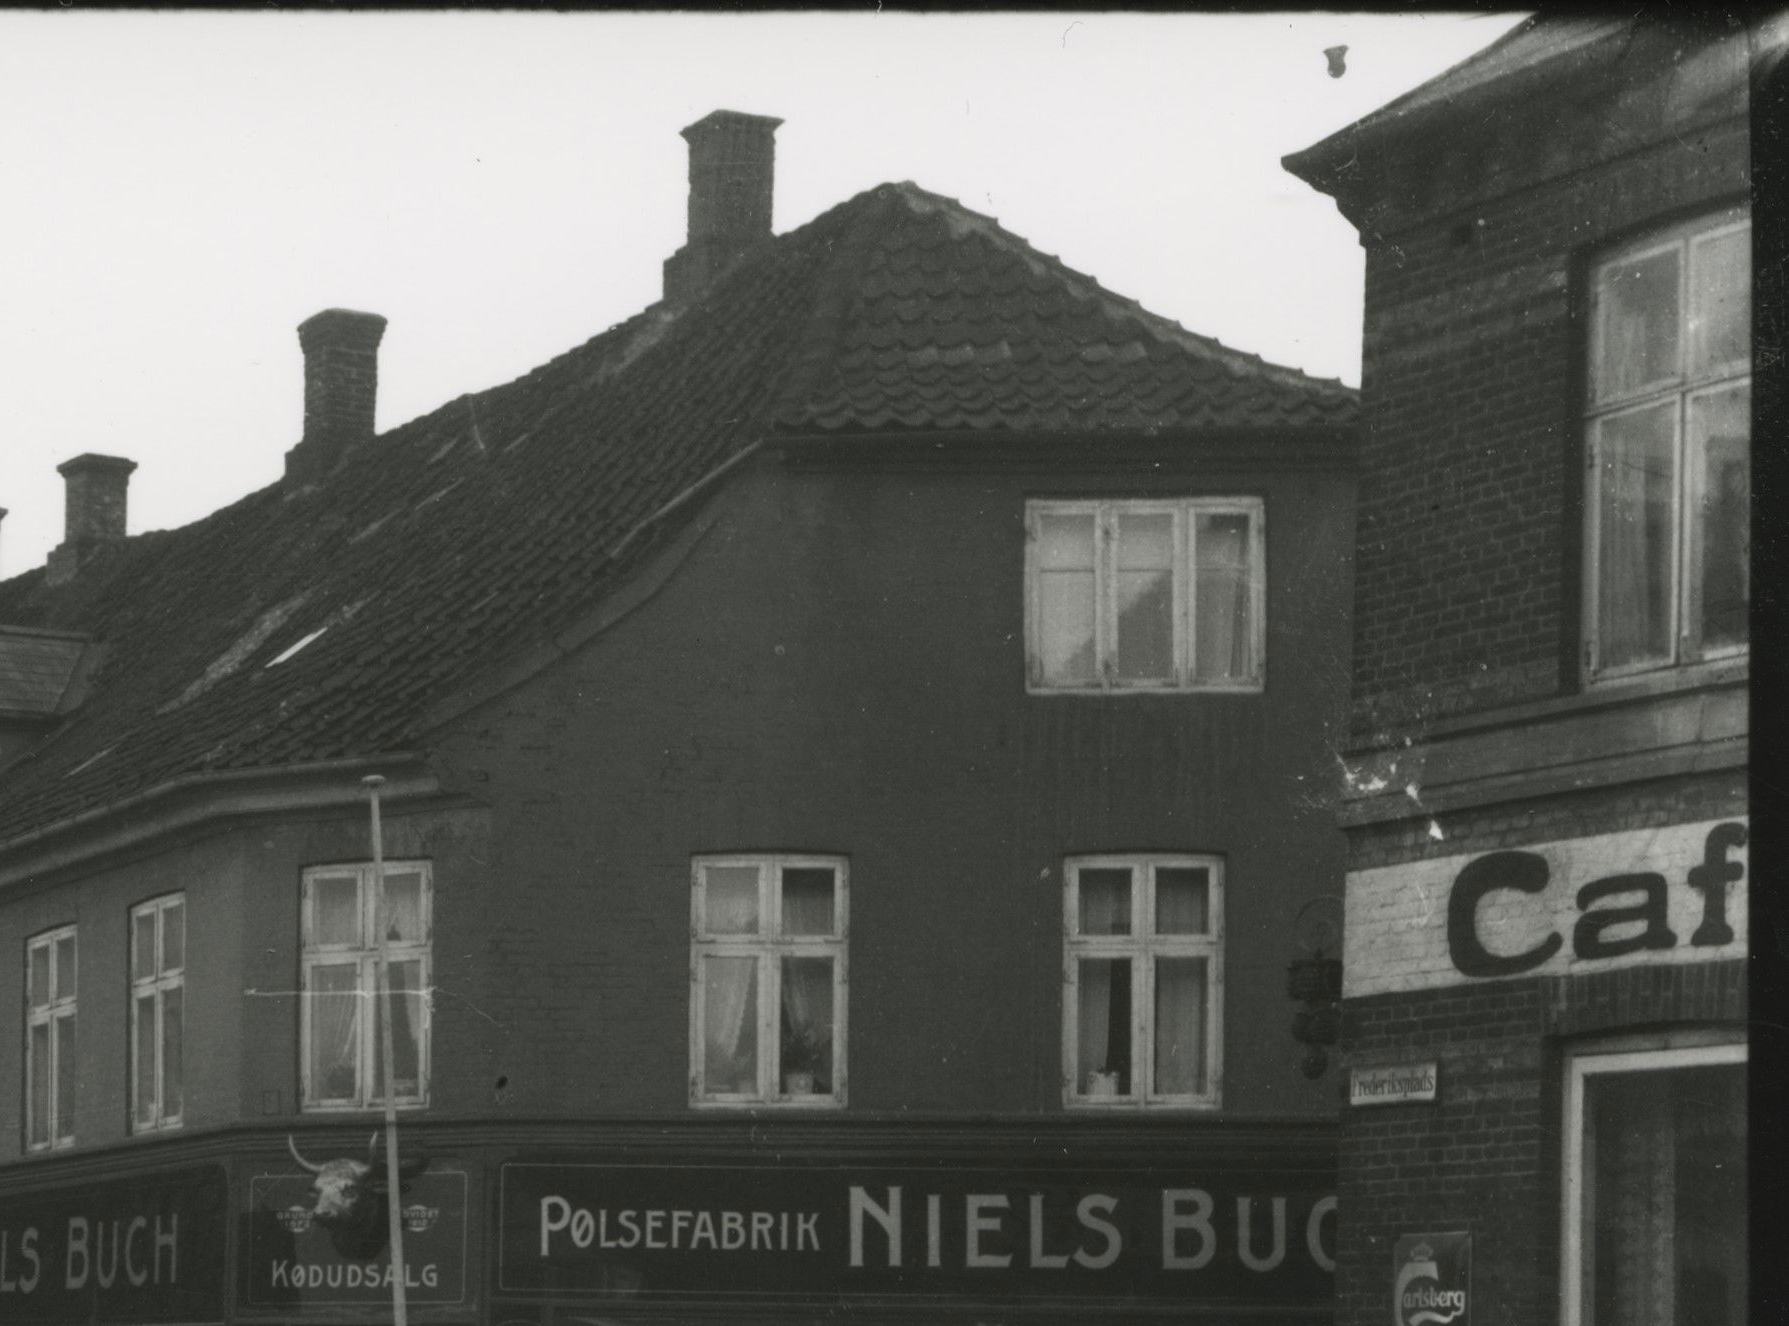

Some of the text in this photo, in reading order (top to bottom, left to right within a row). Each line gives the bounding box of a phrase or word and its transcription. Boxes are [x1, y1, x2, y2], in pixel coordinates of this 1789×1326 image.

[1448, 822, 1748, 976] Caf
[65, 1213, 178, 1289] BUCH
[540, 1195, 820, 1256] PØLSEFABRIK
[849, 1186, 1122, 1270] NIELS
[272, 1260, 438, 1287] KØDUDSALG
